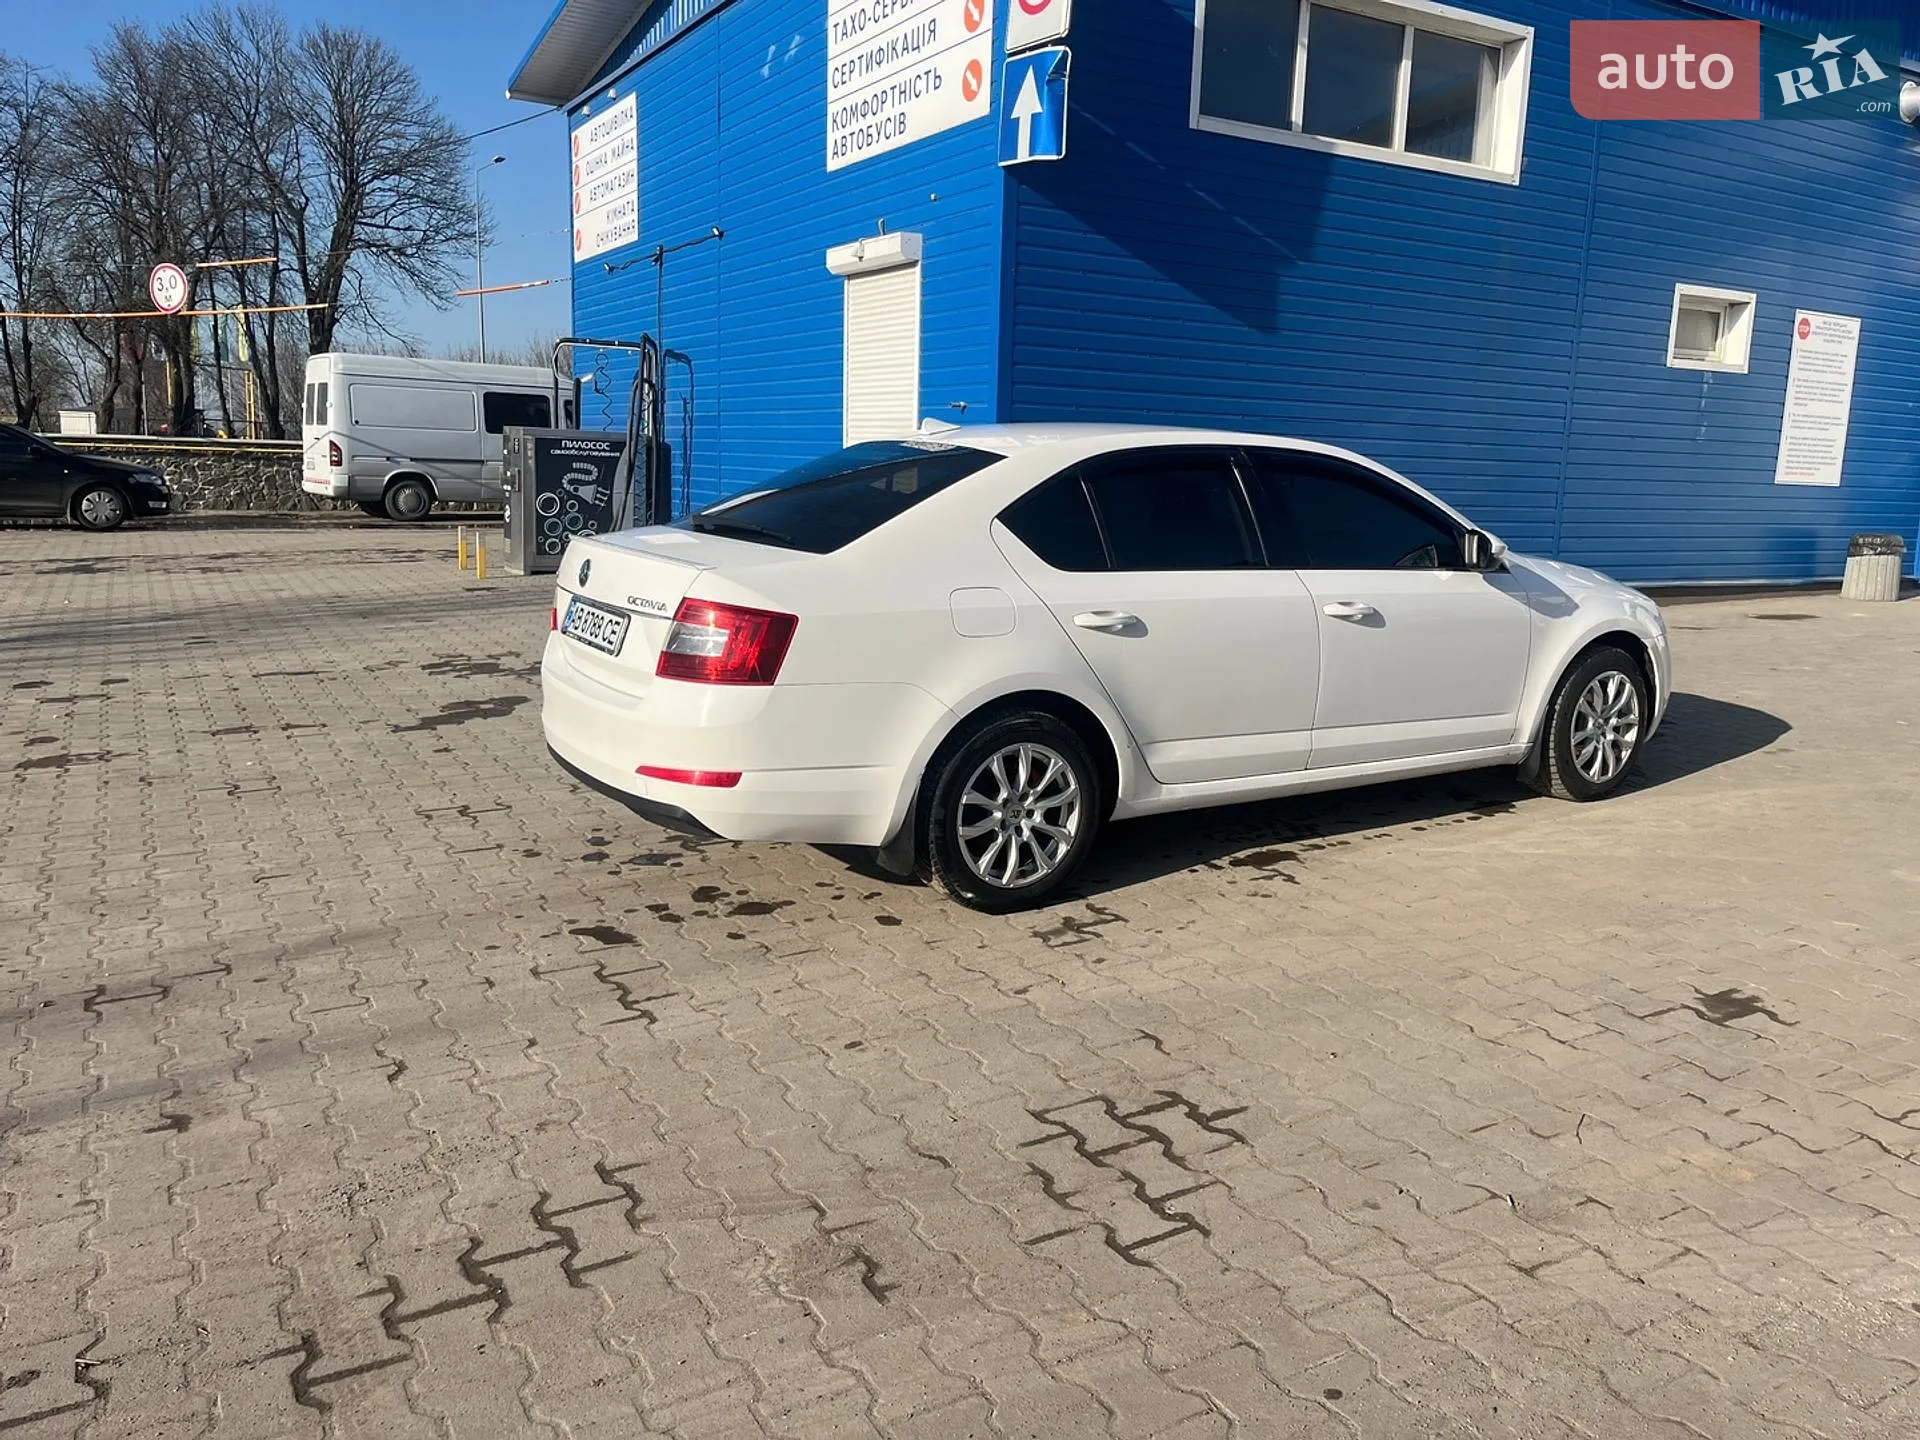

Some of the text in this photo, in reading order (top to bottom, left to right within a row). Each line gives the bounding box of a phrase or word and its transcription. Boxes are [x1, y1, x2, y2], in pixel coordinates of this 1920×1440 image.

[832, 18, 937, 89] СЕРТИФІКАЦІЯ
[832, 67, 942, 133] КОМФОРТНІСТЬ
[831, 112, 907, 161] АВТОБУСІВ
[610, 137, 635, 164] МАЙНА
[589, 169, 635, 203] АВТОМАГАЗИН
[606, 199, 636, 225] КІМНАТА
[561, 440, 611, 450] ПИЛОСОС
[627, 595, 668, 612] OCTAVIA
[602, 619, 621, 646] CE
